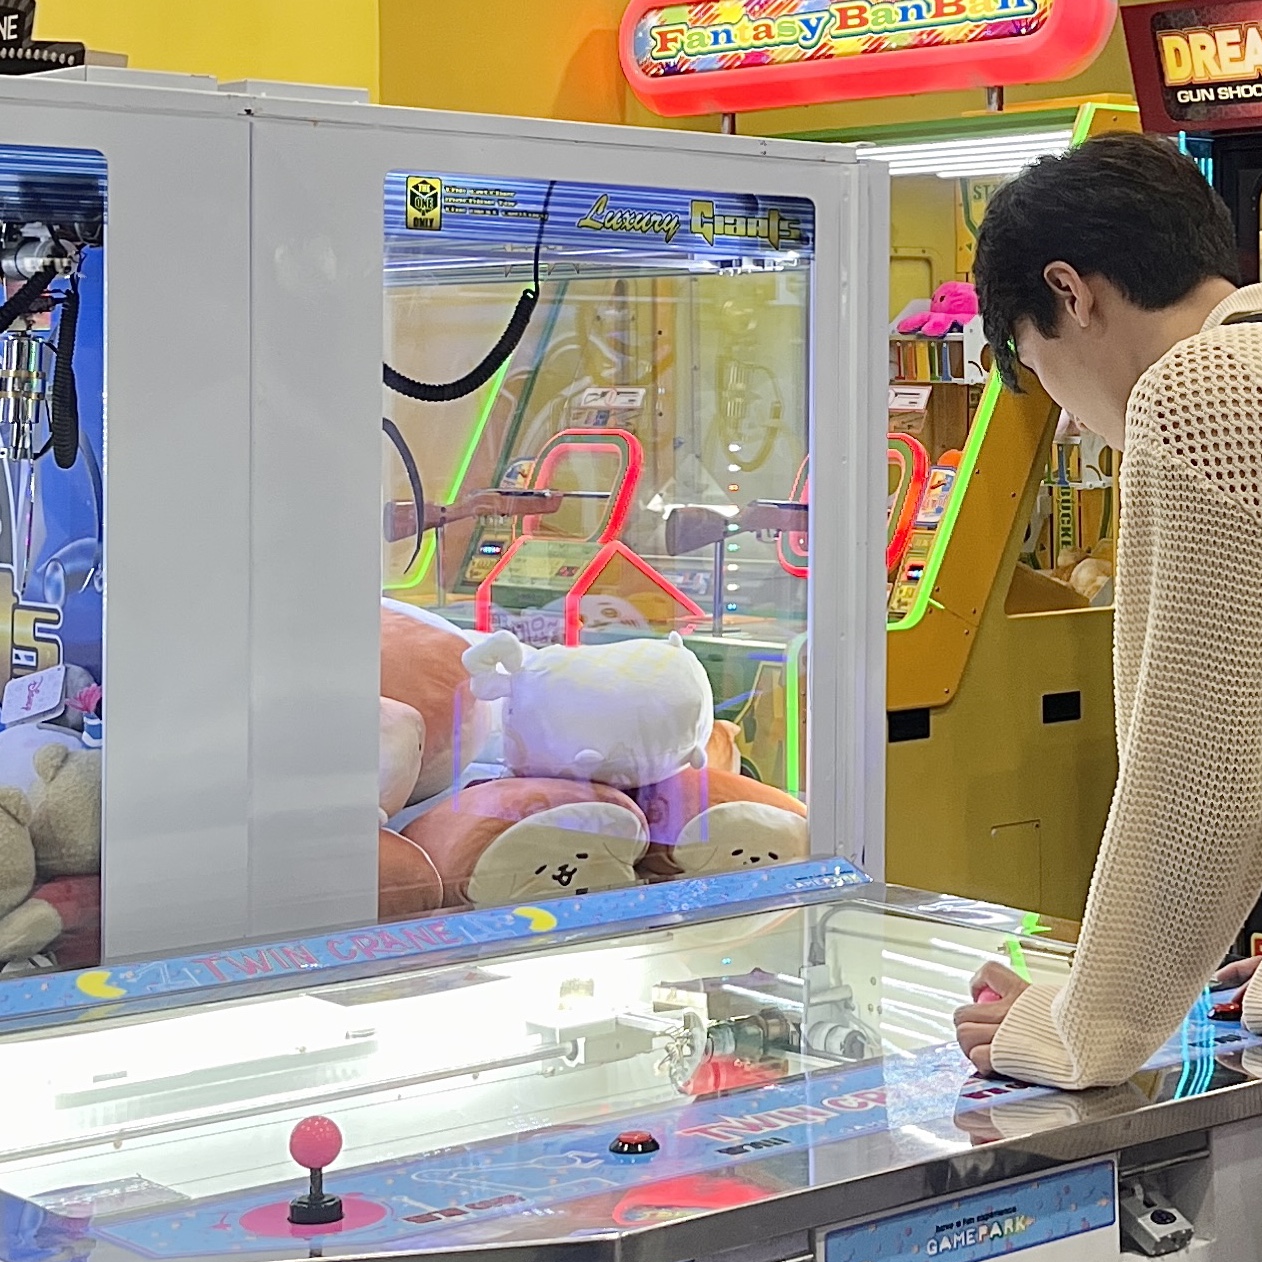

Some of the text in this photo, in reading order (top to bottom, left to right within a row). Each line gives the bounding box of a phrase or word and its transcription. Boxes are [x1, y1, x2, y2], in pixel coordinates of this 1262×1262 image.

[1176, 85, 1215, 104] GUN
[577, 194, 802, 251] Luxury Giants
[194, 921, 462, 983] TWIN CRANE
[676, 1104, 840, 1143] TWIN
